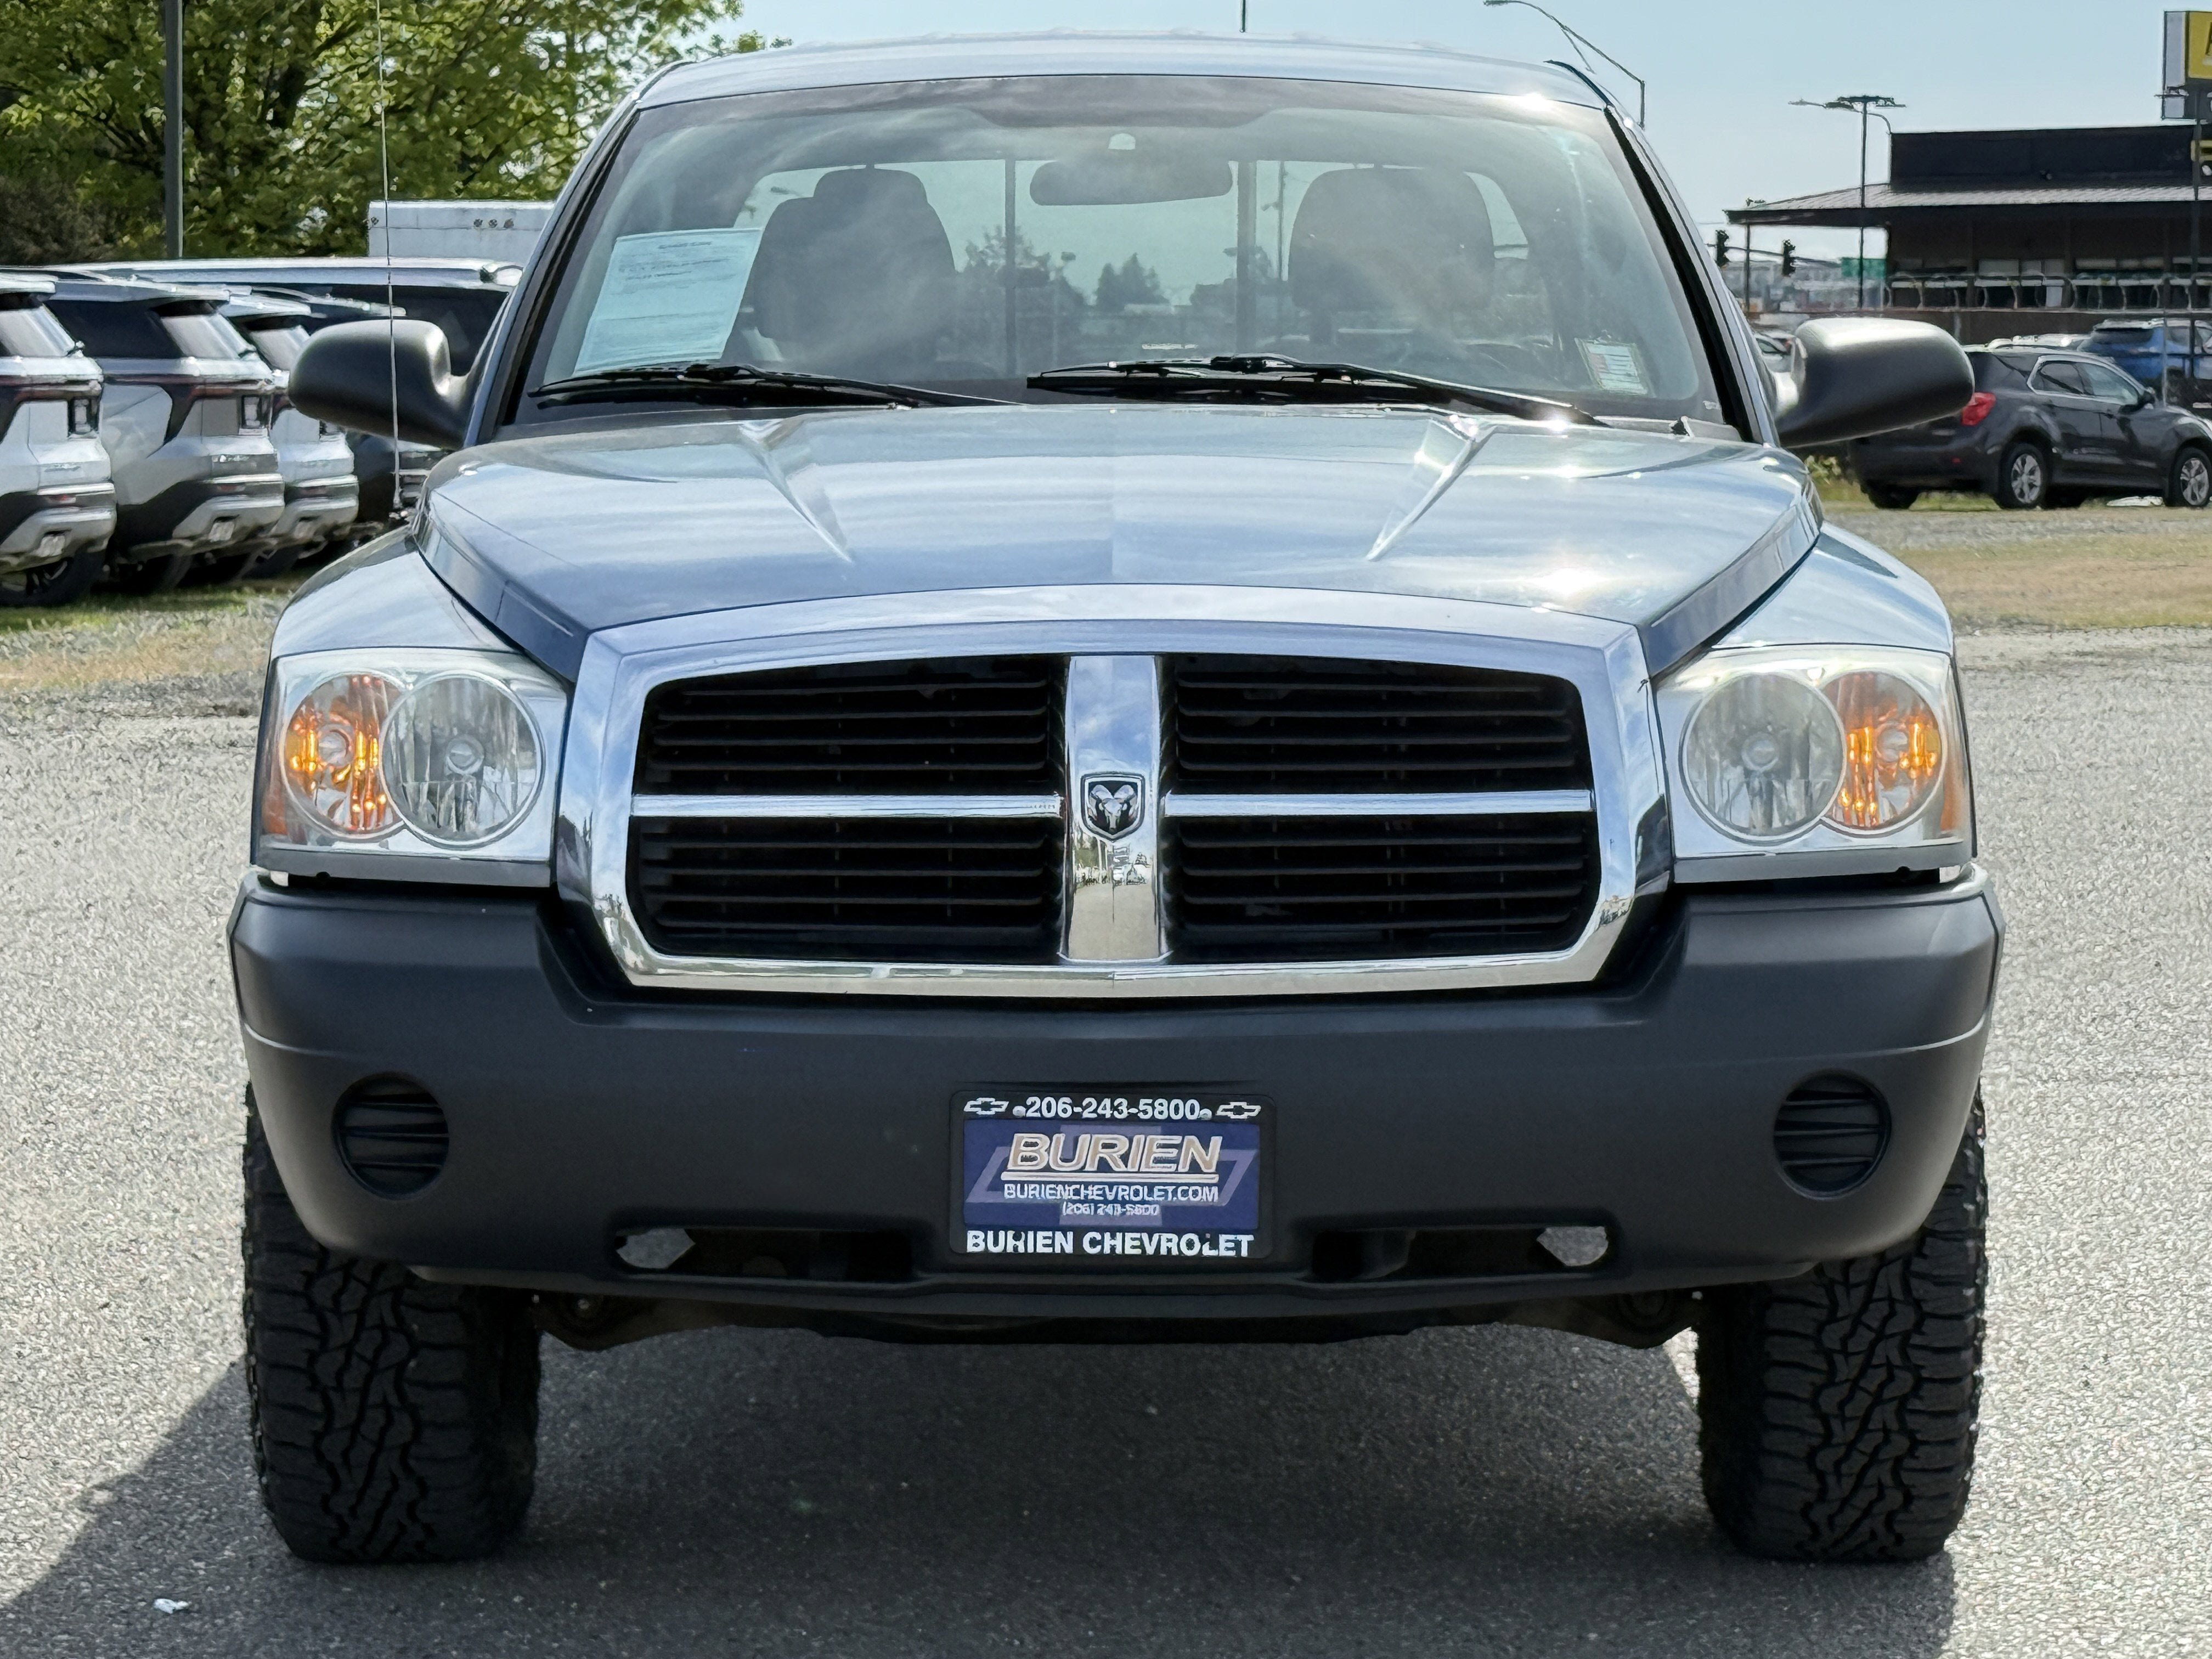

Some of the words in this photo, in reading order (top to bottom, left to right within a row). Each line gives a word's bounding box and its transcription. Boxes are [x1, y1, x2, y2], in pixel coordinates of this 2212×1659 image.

[1025, 1097, 1200, 1120] 206-243-5800
[1007, 1133, 1223, 1173] BURIEN
[1003, 1183, 1219, 1203] BURIENCHEVROLET.COM
